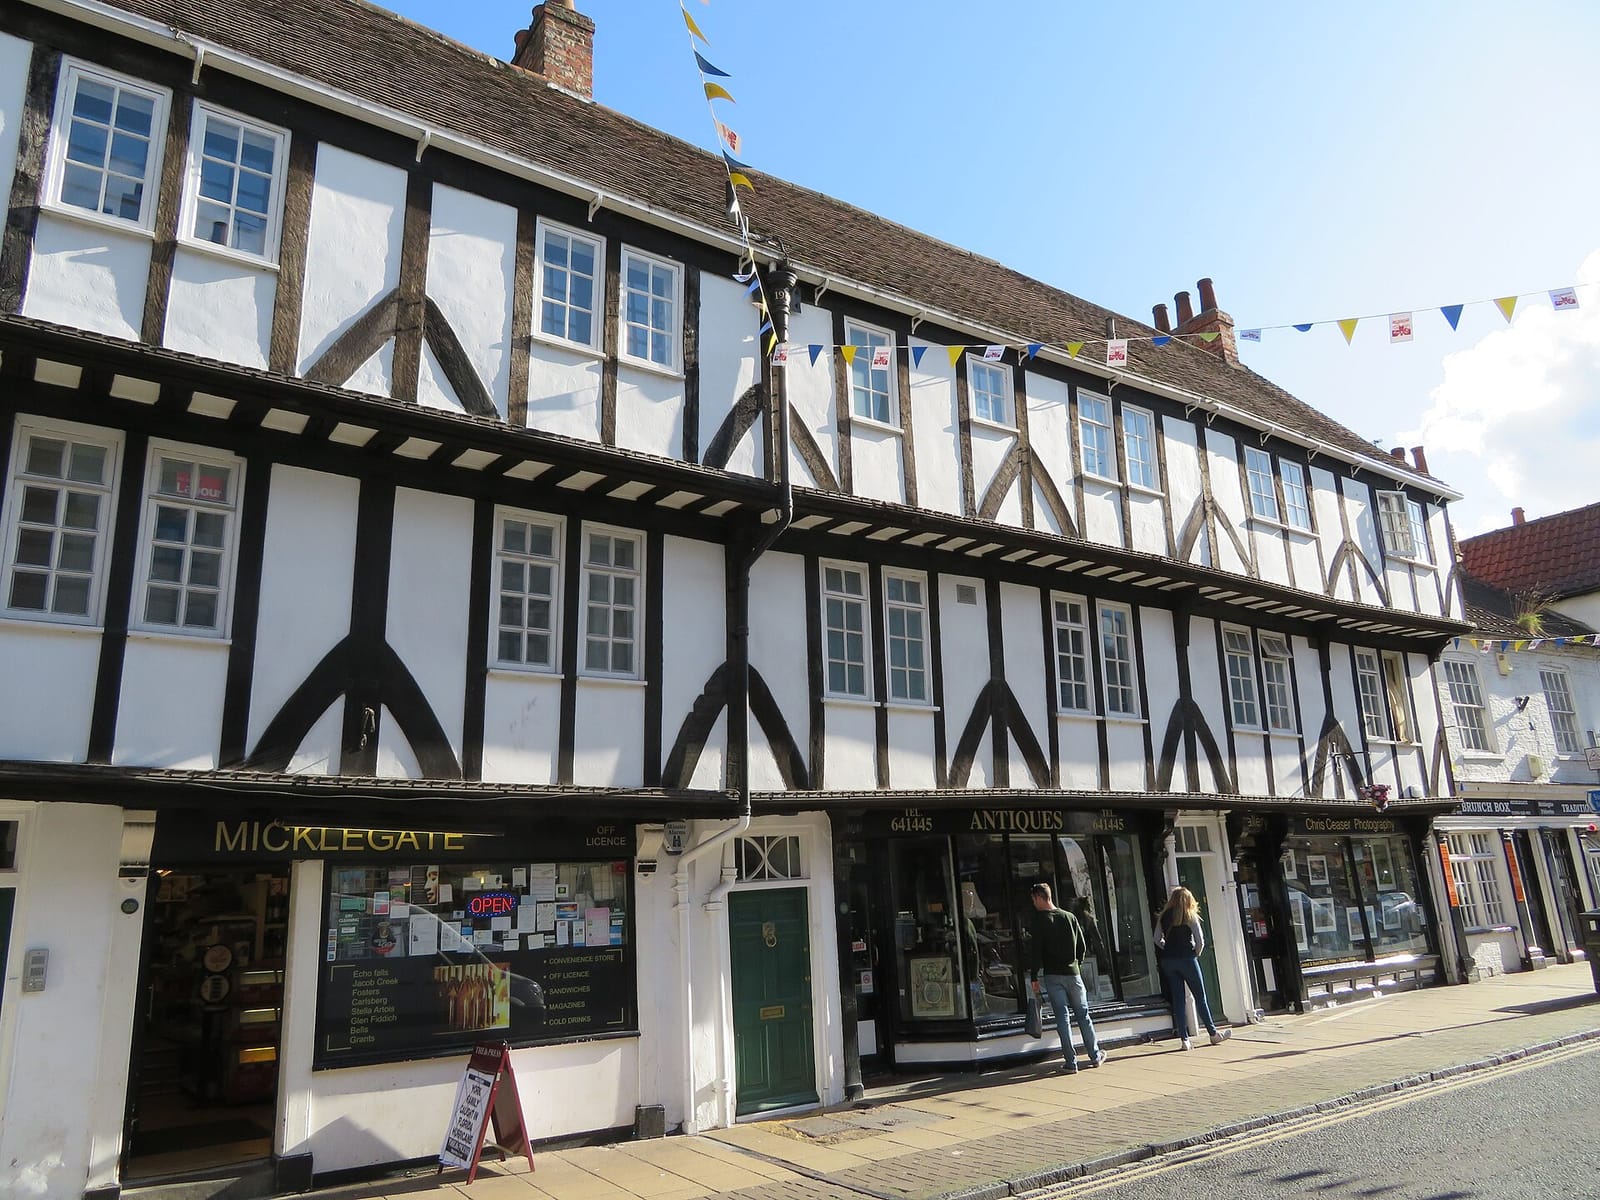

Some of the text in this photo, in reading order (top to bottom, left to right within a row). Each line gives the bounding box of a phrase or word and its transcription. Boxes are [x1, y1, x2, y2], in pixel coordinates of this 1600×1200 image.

[1461, 801, 1494, 813] BRUNCH
[1495, 802, 1511, 813] BOX
[1561, 804, 1592, 813] TRADITIO
[891, 818, 933, 832] 641445
[970, 810, 1064, 833] ANTIQUES
[1092, 818, 1124, 831] 641445
[1305, 818, 1395, 832] Chris Ceaser Photography
[596, 825, 615, 835] OFF
[215, 821, 465, 851] MICKLEGATE
[586, 837, 627, 847] LICENCE
[471, 897, 513, 913] OPEN
[549, 956, 594, 965] CONVENIENCE
[353, 970, 373, 978] Echo
[562, 971, 590, 979] LICENCE
[352, 977, 399, 987] Jacob Creek
[352, 988, 380, 996] Fosters
[549, 986, 591, 995] SANDWICHES
[351, 998, 388, 1006] Carlsberg
[549, 1001, 586, 1010] MAGAZINES
[351, 1006, 396, 1015] Stella Artois
[350, 1015, 398, 1025] Glen Fiddich
[549, 1016, 592, 1026] COLD DRINKS
[350, 1026, 369, 1034] Bells
[349, 1035, 376, 1044] Grants
